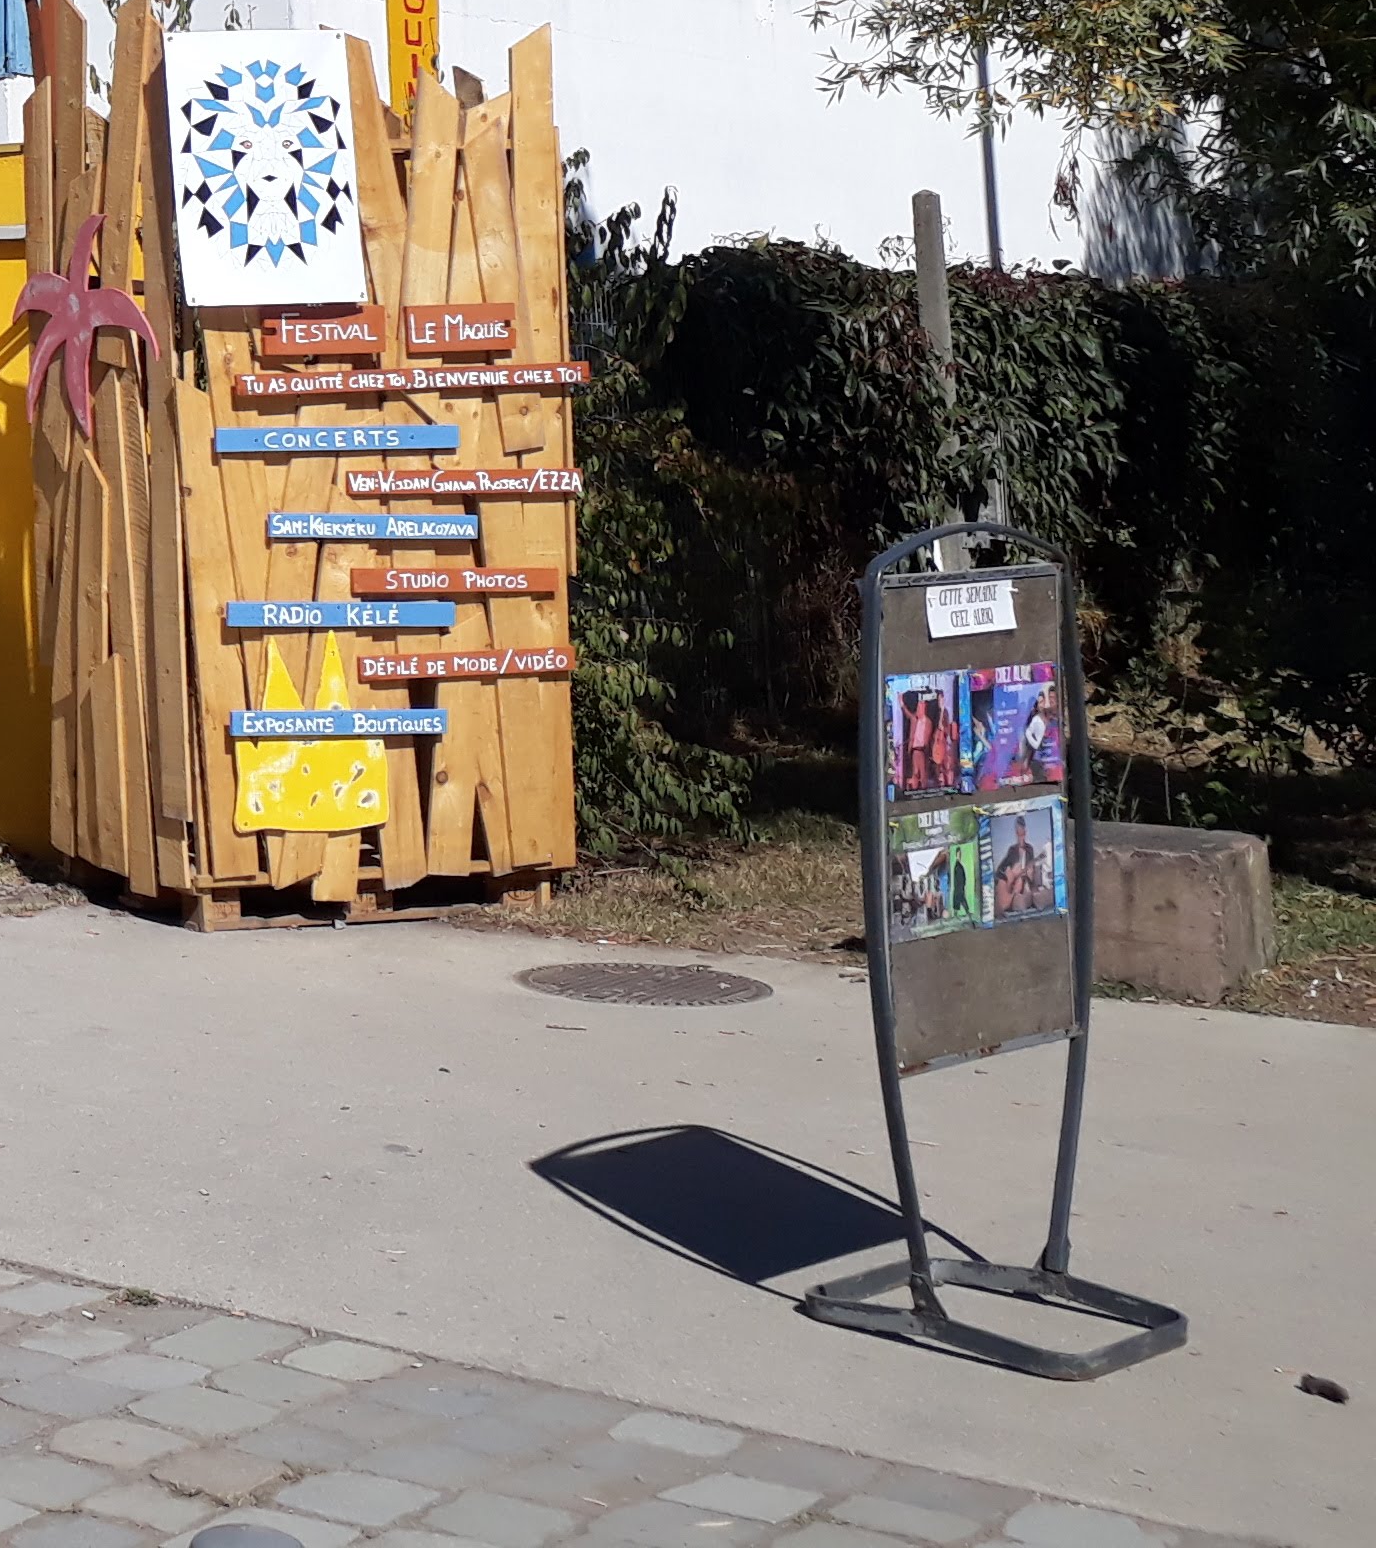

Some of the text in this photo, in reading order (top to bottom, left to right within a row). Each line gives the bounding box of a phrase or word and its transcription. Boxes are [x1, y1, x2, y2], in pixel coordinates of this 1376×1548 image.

[281, 313, 378, 344] FESTIVAL
[410, 314, 510, 344] LE MAQUIS
[242, 375, 264, 394] TU
[268, 378, 287, 394] AS
[291, 372, 343, 392] QUITTÉ
[349, 371, 385, 389] CHEZ
[413, 369, 509, 388] BIENVENUE
[513, 369, 554, 384] CHEZ
[558, 366, 583, 383] TOI
[264, 430, 400, 449] CONCERTS
[432, 470, 477, 493] GNAWA
[386, 570, 528, 589] STUDIO PHOTOS
[939, 584, 998, 606] CETTE SEMAINE
[263, 603, 399, 626] RADIO KÉLÉ
[951, 607, 994, 628] CHEZ ALRIQ
[363, 656, 419, 676] DÉFILÉ
[427, 659, 446, 675] DE
[242, 712, 442, 733] EXPOSANTS BOUTIQUES
